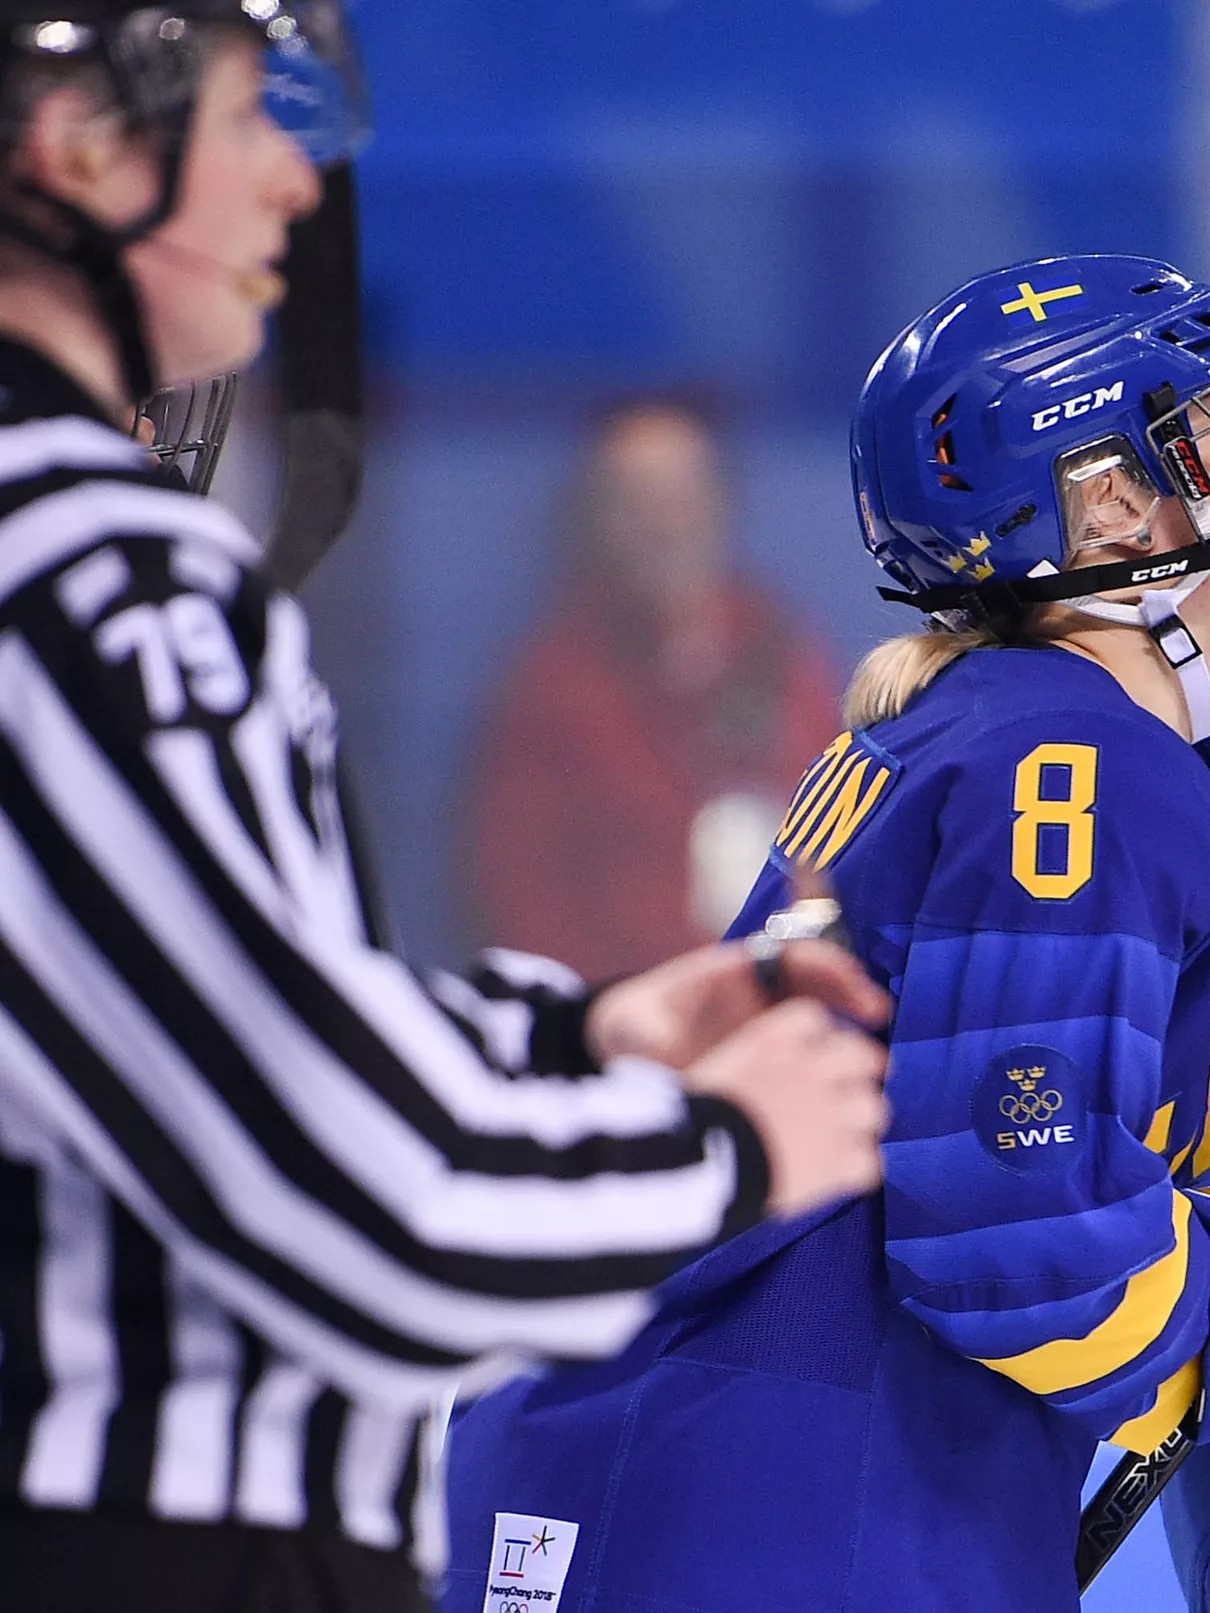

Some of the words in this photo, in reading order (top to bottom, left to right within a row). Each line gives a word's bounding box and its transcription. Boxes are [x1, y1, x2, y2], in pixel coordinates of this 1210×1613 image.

[1032, 381, 1125, 431] CCM
[1131, 559, 1189, 582] CCM
[1011, 743, 1098, 899] 8
[997, 1125, 1075, 1150] SWE
